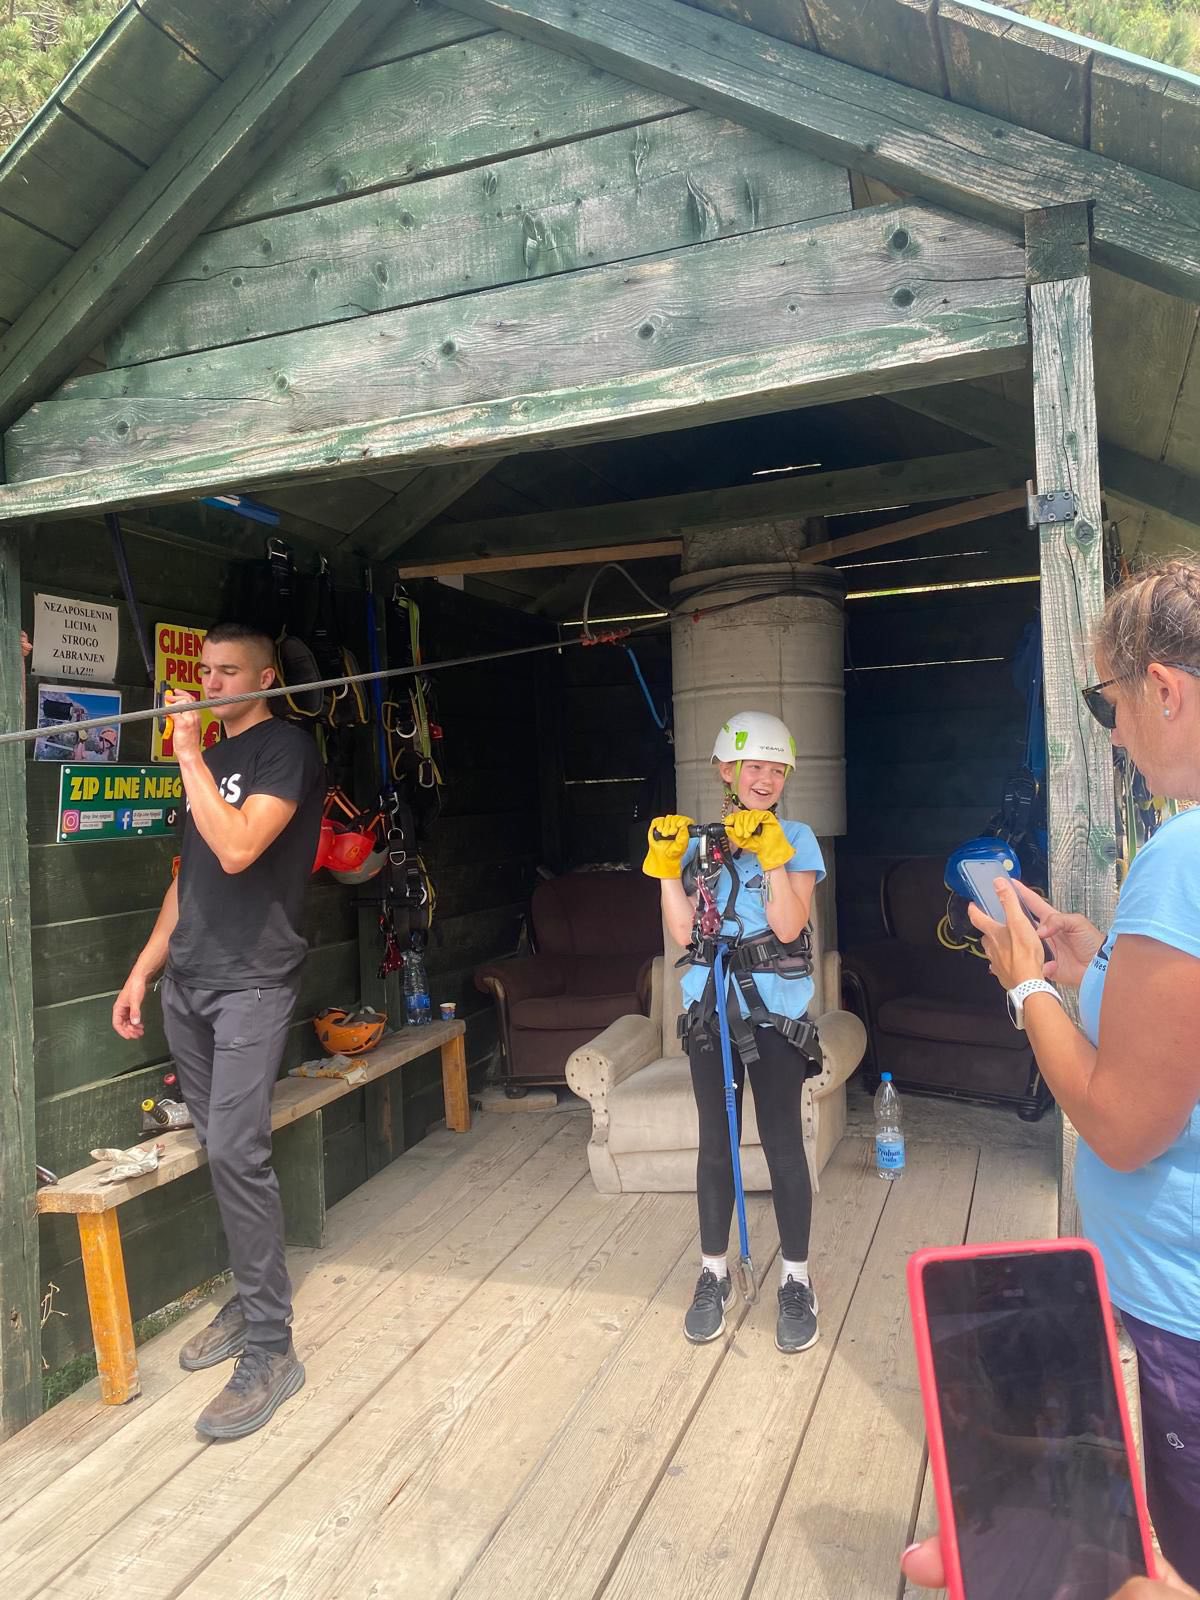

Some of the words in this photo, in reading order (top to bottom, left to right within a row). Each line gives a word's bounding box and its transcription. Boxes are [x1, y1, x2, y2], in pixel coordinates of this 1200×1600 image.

[44, 601, 112, 621] NEZAPOSLENIM
[64, 619, 97, 632] LICIMA
[62, 634, 99, 648] STROGO
[158, 628, 206, 657] CIJEN
[53, 648, 105, 663] ZABRANJEN
[62, 665, 94, 677] ULAZ!!!
[166, 658, 202, 685] PRIC
[70, 776, 100, 801] ZIP
[104, 776, 141, 800] LINE
[144, 776, 183, 799] NJEG
